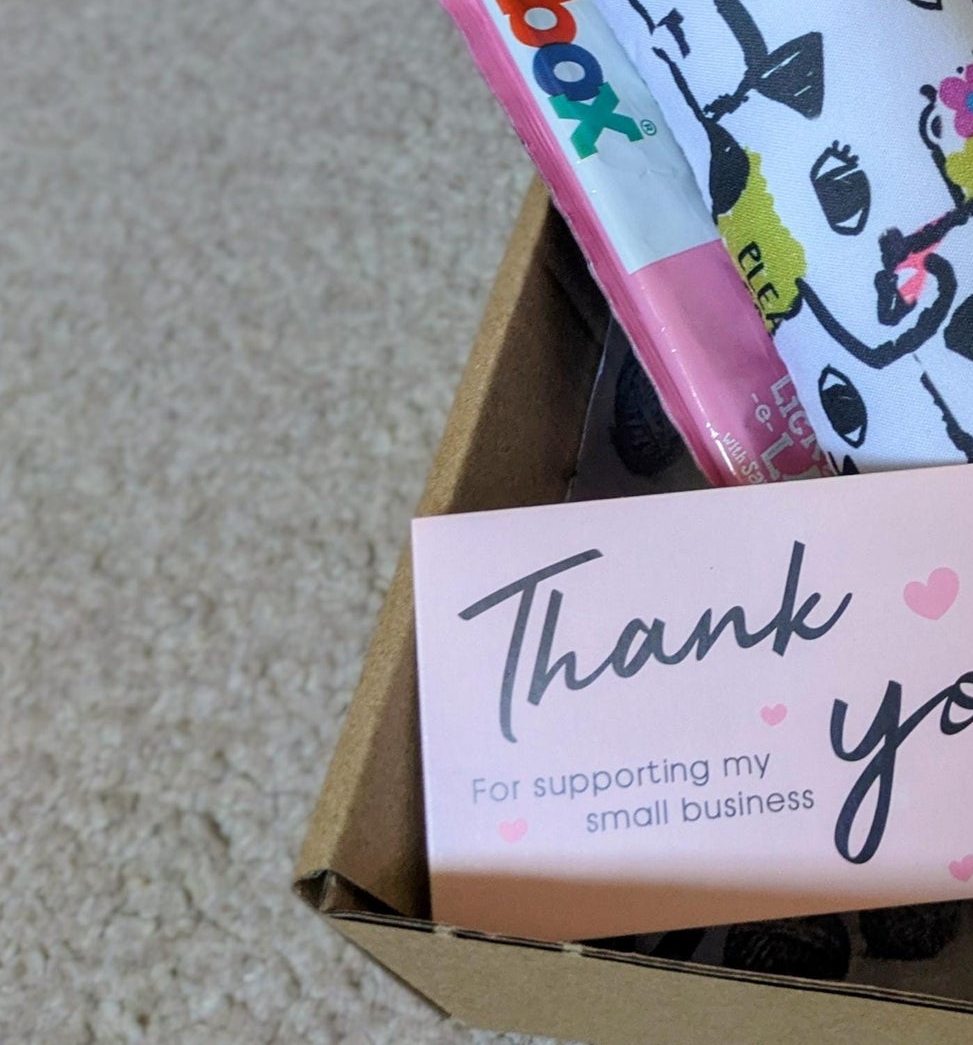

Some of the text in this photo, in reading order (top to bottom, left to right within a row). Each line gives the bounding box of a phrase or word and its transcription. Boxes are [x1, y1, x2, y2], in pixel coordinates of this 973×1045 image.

[741, 461, 768, 484] Sa
[458, 540, 853, 743] Thank
[472, 753, 771, 805] For supporting my
[586, 788, 815, 833] small business
